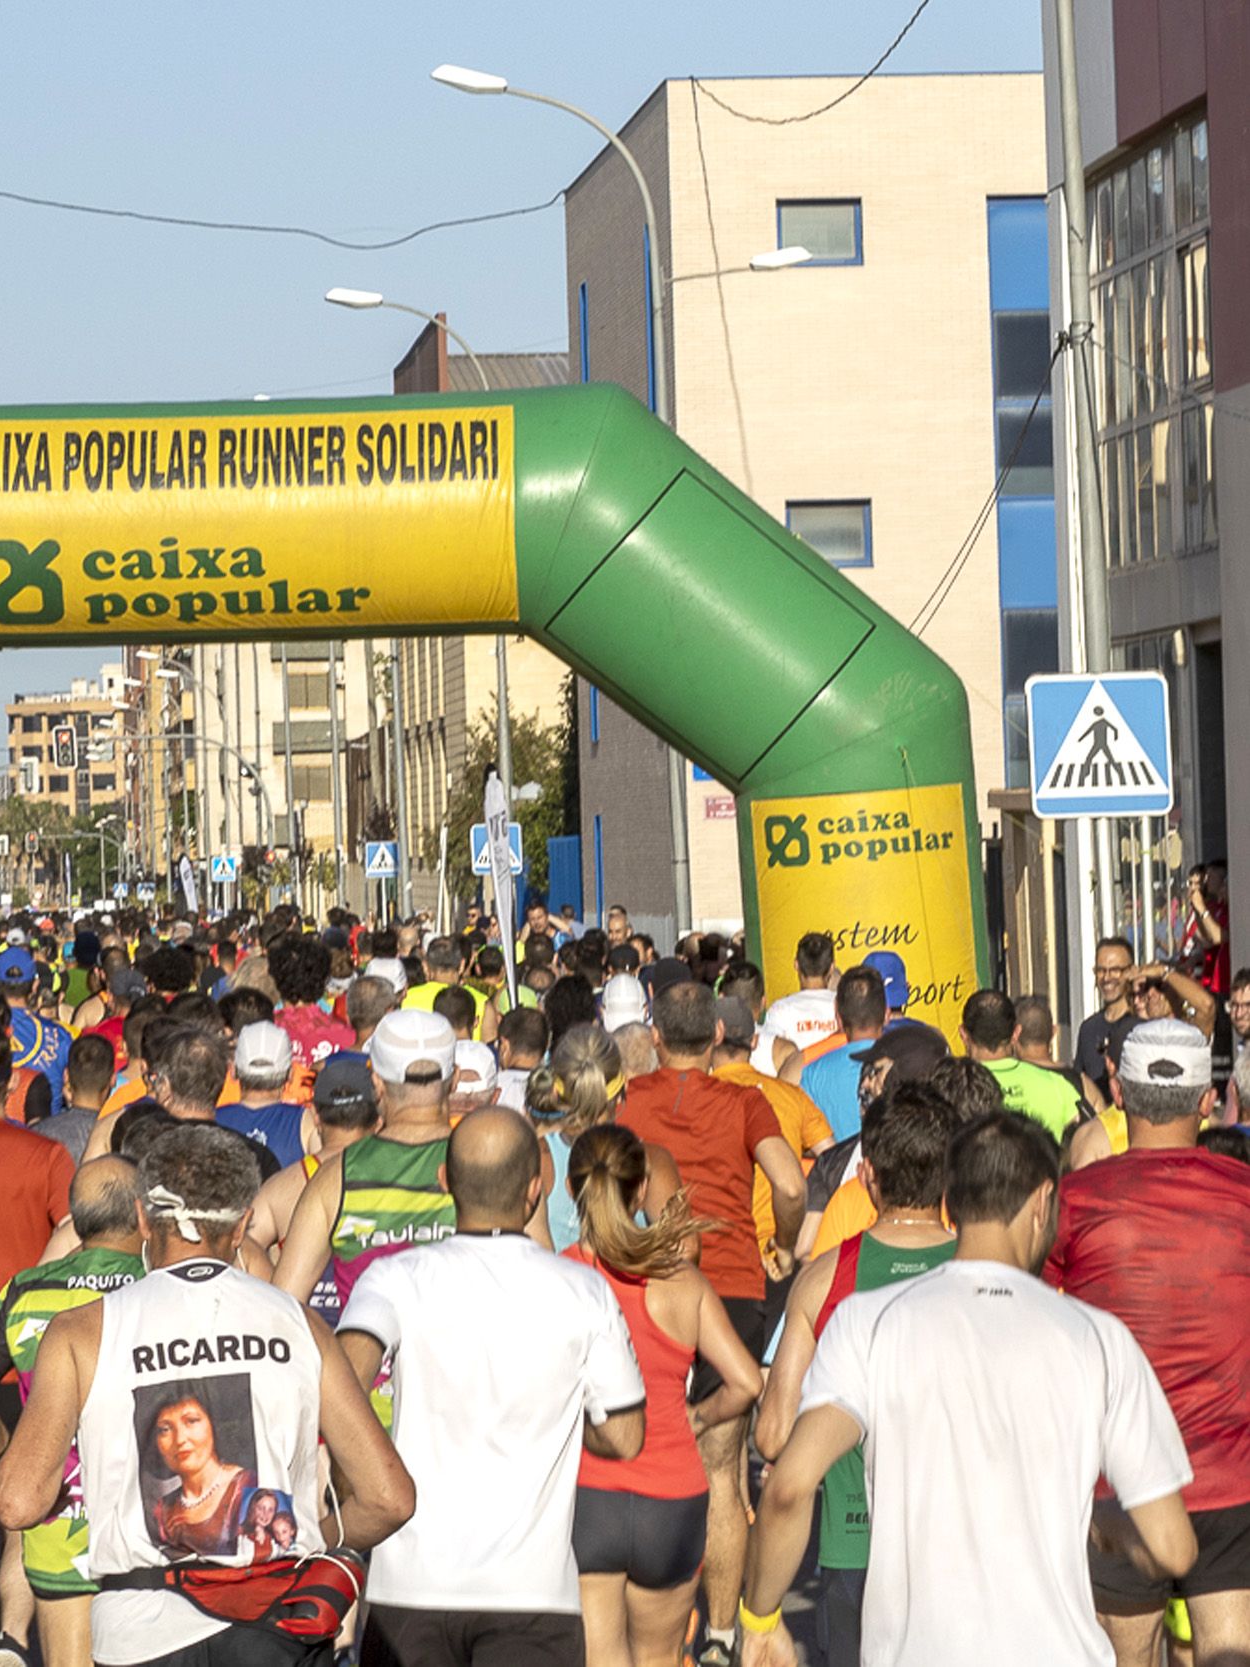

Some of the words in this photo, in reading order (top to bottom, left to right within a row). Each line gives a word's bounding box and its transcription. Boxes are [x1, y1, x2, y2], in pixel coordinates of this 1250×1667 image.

[63, 429, 207, 492] POPULAR
[219, 425, 346, 490] RUNNER
[356, 419, 498, 486] SOLIDARI
[82, 537, 265, 580] caixa
[84, 580, 371, 624] popular
[818, 810, 910, 834] caixa
[820, 830, 953, 864] popular
[904, 974, 966, 1014] port
[67, 1273, 135, 1291] PAQUITO
[132, 1334, 291, 1374] RICARDO
